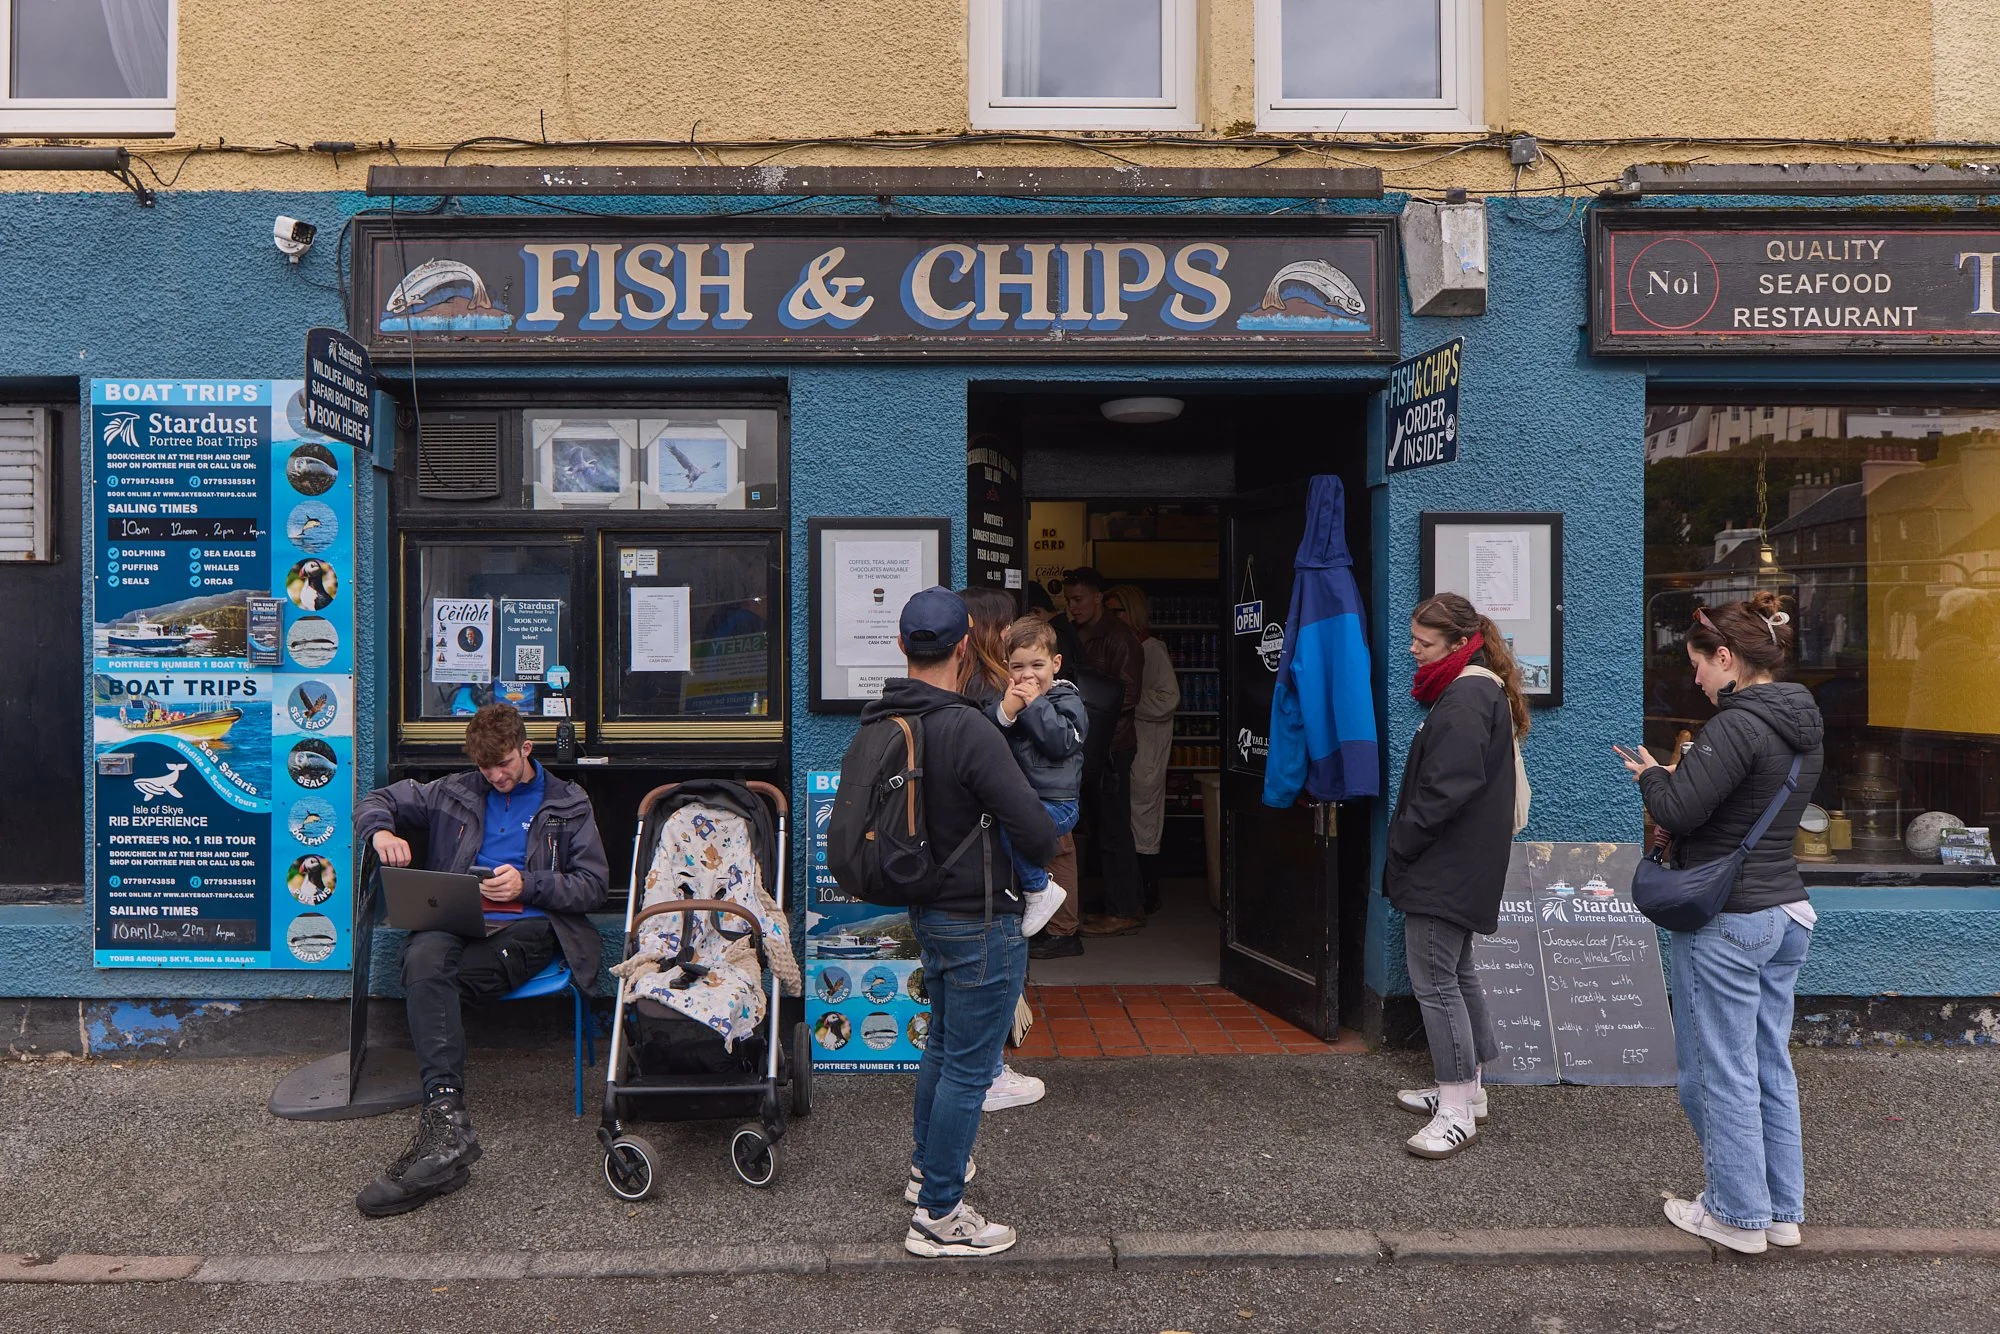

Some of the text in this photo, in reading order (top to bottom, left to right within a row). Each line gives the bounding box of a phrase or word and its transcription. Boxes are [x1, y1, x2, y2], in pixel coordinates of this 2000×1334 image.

[1766, 239, 1885, 262] QUALITY
[517, 241, 1231, 332] FISH & CHIPS
[1759, 273, 1891, 294] SEAFOOD
[1734, 306, 1917, 328] RESTAURANT
[339, 343, 362, 367] Stardust
[313, 358, 368, 399] WILDLIFE AND SEA
[105, 383, 258, 401] BOAT TRIPS
[312, 380, 368, 419] SAFARI BOAT TRIPS
[149, 413, 258, 433] Stardust
[317, 404, 362, 441] BOOK HERE
[1405, 398, 1445, 435] ORDER
[149, 436, 258, 448] Portree Boat Trips
[1403, 431, 1444, 466] INSIDE
[108, 504, 198, 514] SAILING TIMES
[1042, 529, 1057, 538] NO
[1034, 540, 1065, 550] CARD
[978, 548, 986, 560] FISH
[437, 604, 489, 621] Cèilidh
[1237, 612, 1259, 630] OPEN
[109, 679, 257, 696] BOAT TRIPS
[291, 704, 335, 729] SEA EAGLES
[177, 741, 204, 768] Wildlife
[210, 774, 232, 798] Scenic
[234, 796, 257, 808] Tours
[200, 741, 257, 795] Sea Safaris
[298, 774, 328, 787] SEALS
[133, 805, 183, 817] Isle of Skye
[108, 817, 208, 827] RIB EXPERIENCE
[110, 836, 256, 845] PORTREE'S 1 RIB TOUR
[291, 825, 334, 845] DOLPHINS
[110, 906, 199, 915] SAILING TIMES
[1512, 915, 1534, 923] Trips
[1542, 929, 1585, 947] Jurassic
[292, 945, 331, 961] WHALES
[1505, 962, 1534, 976] seating
[1573, 975, 1634, 987] hours with
[818, 988, 849, 1003] SEA EAGLES
[866, 992, 894, 1004] DOLPHINS
[911, 992, 921, 1002] SEA
[1493, 985, 1522, 995] toilet
[1612, 995, 1642, 1006] scenery
[867, 1040, 892, 1049] WHALES
